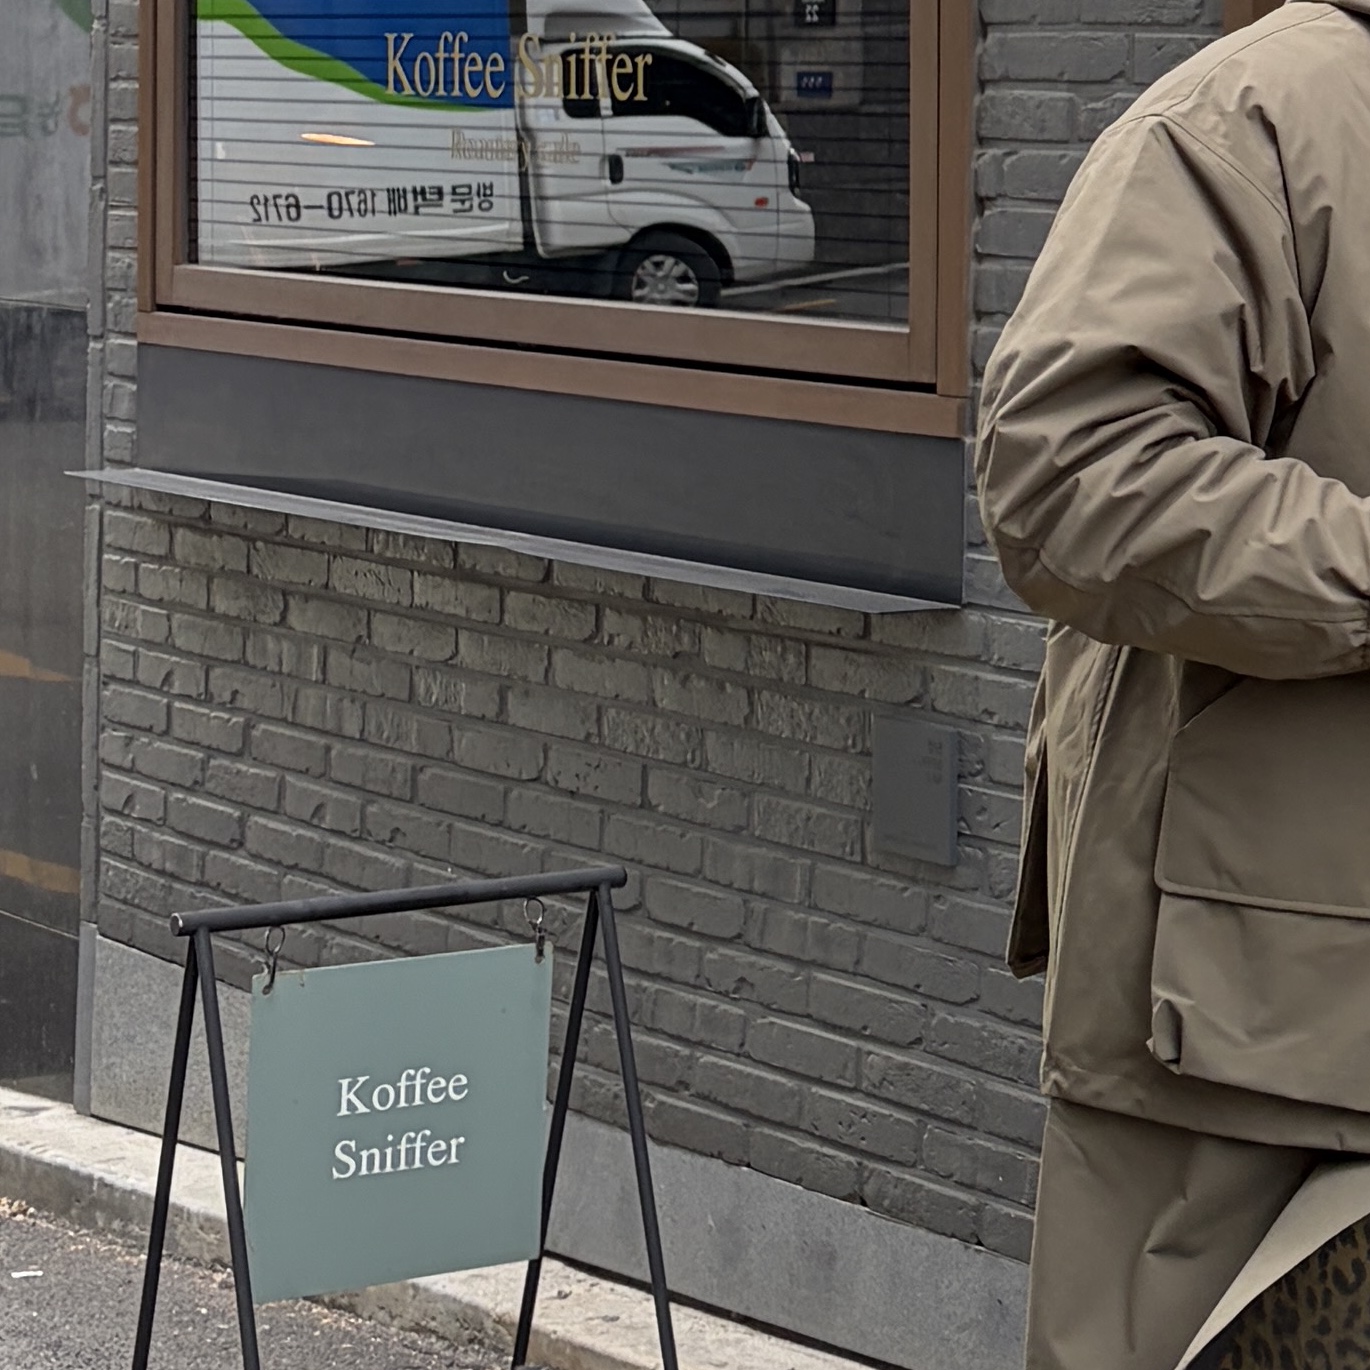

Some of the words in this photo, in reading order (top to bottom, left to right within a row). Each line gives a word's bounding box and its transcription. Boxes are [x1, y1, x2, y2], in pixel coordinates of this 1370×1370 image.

[384, 31, 505, 98] Koffee
[518, 32, 653, 102] Sniffer
[336, 1066, 469, 1117] Koffee
[332, 1129, 466, 1180] Sniffer
